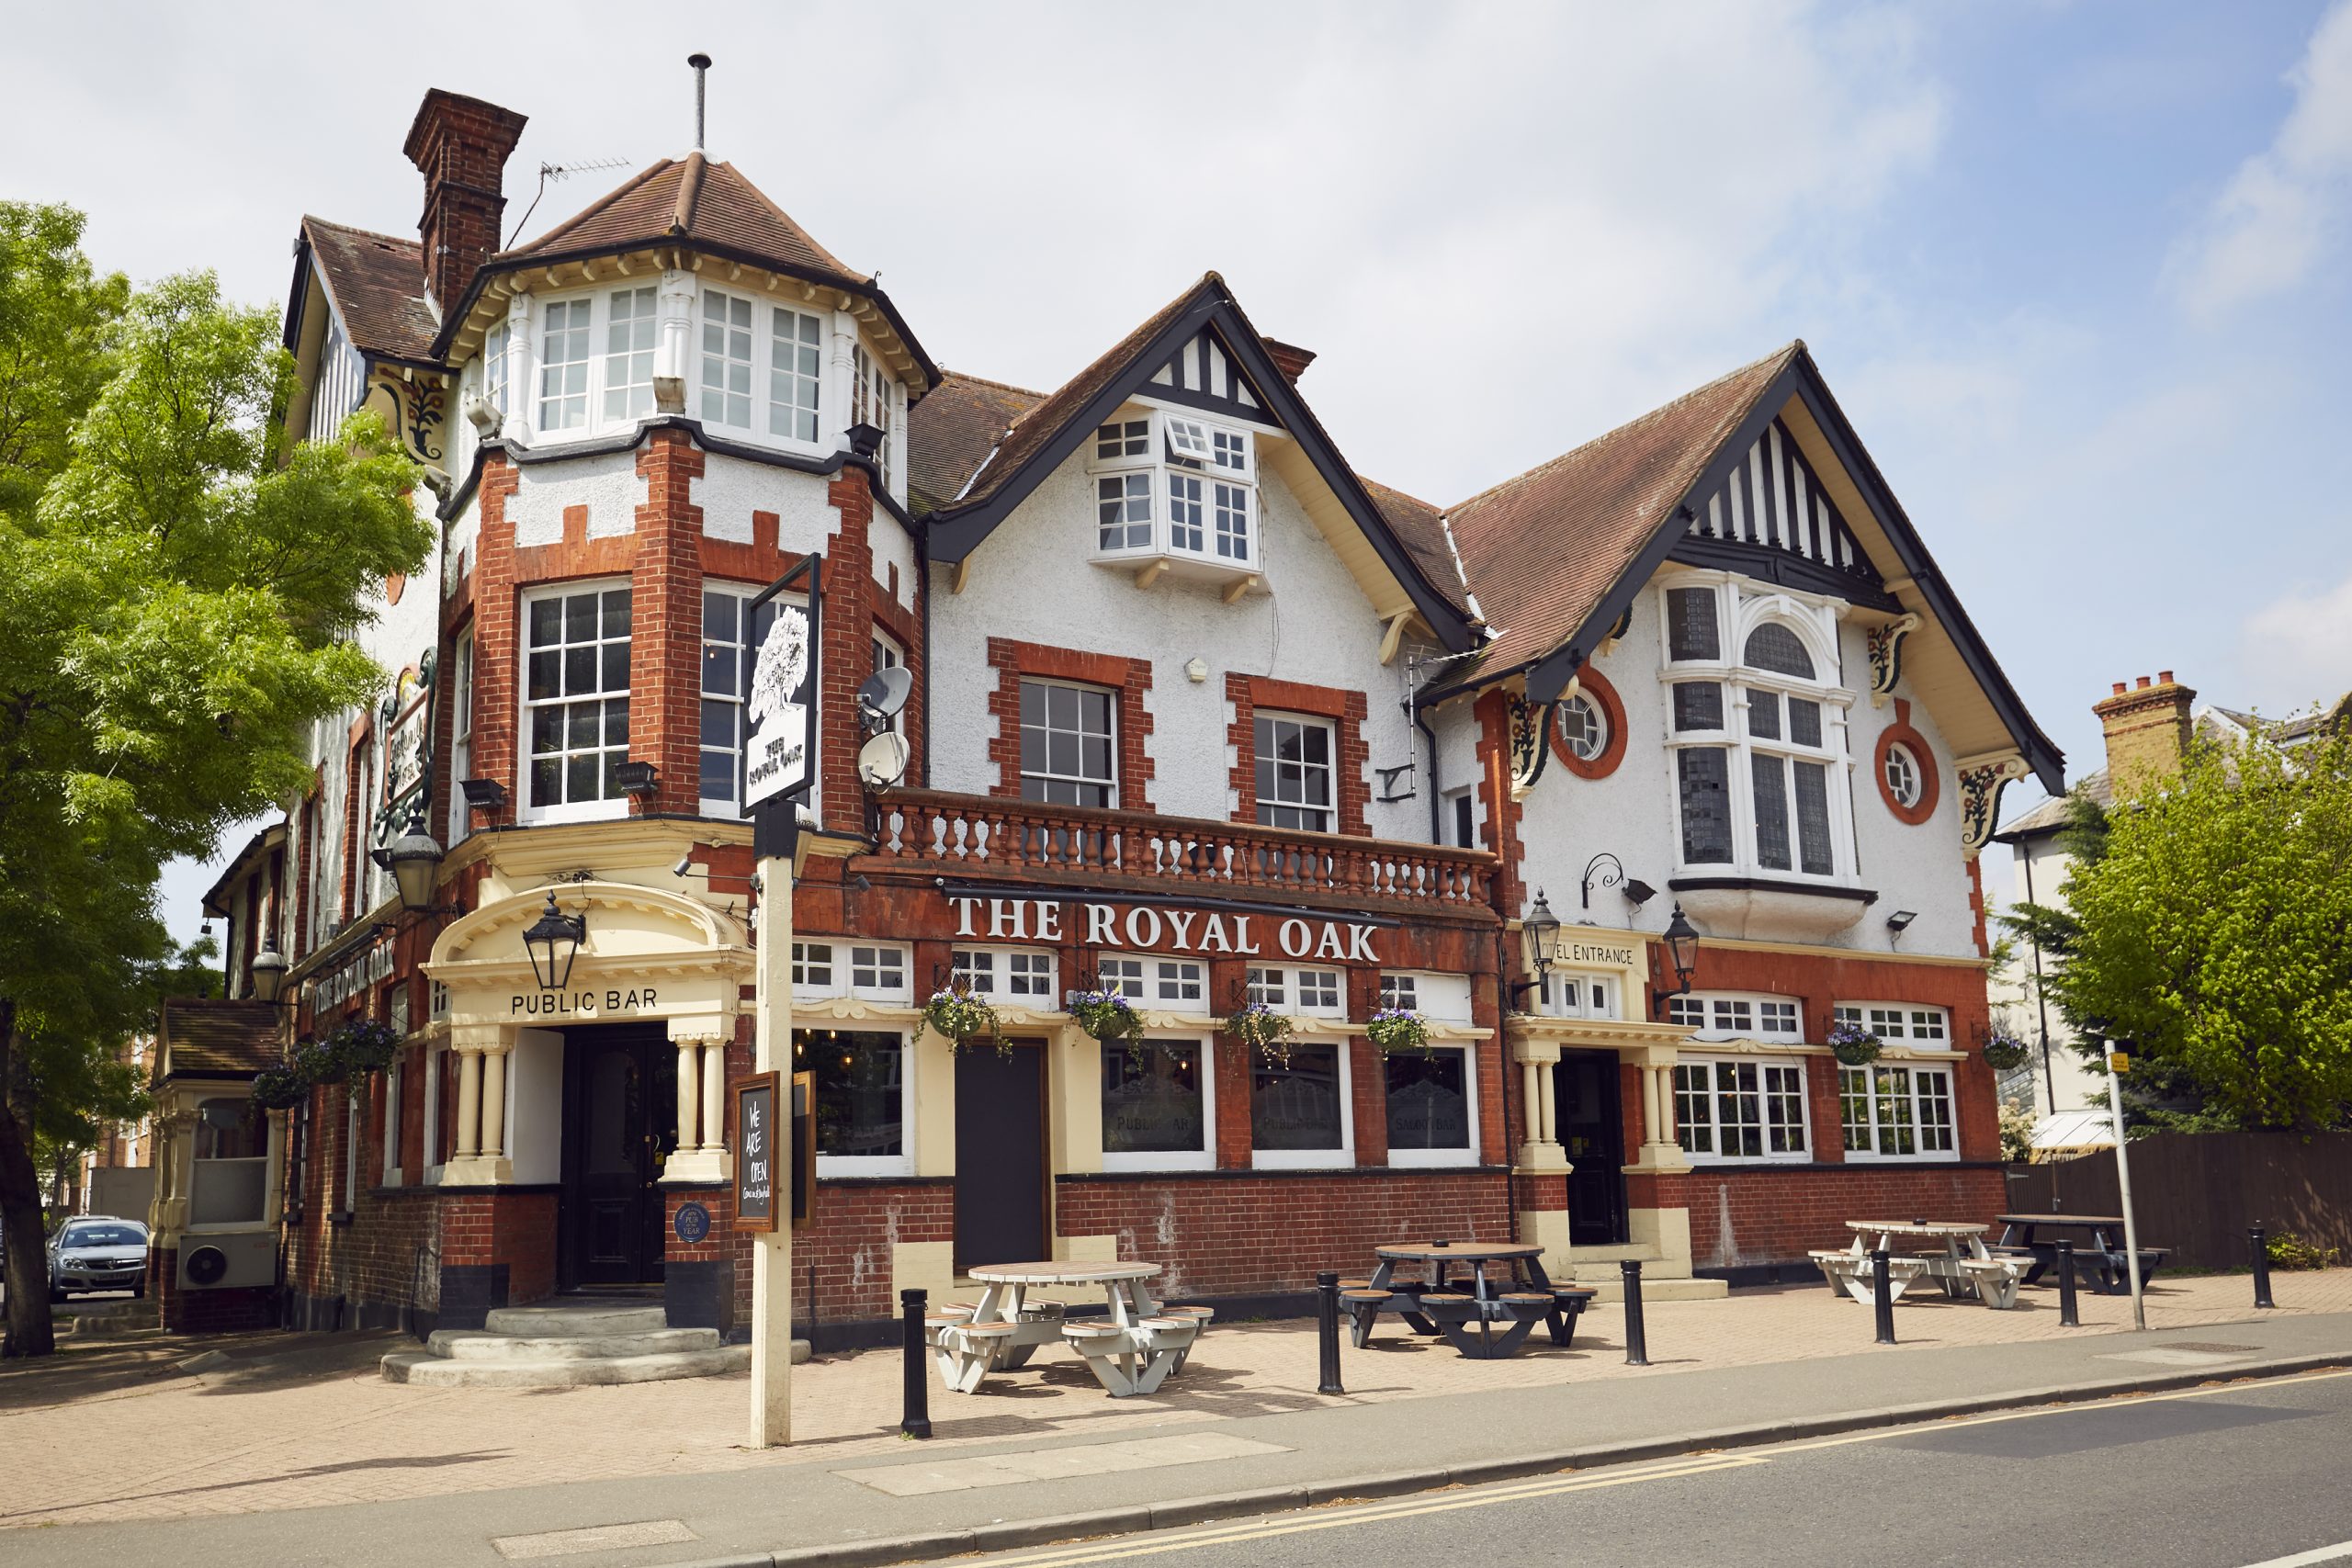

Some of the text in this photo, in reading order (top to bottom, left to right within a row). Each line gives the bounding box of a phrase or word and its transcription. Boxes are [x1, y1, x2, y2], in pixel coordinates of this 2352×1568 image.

[765, 737, 785, 758] THE
[749, 743, 803, 787] ROYAL OAK
[948, 897, 1381, 963] THE ROYAL OAK
[1539, 943, 1634, 965] OTEL ENTRANCE
[314, 937, 395, 1016] THE ROYAL OAK
[512, 988, 657, 1015] PUBLIC BAR
[749, 1100, 761, 1129] WE
[746, 1130, 762, 1157] ARE
